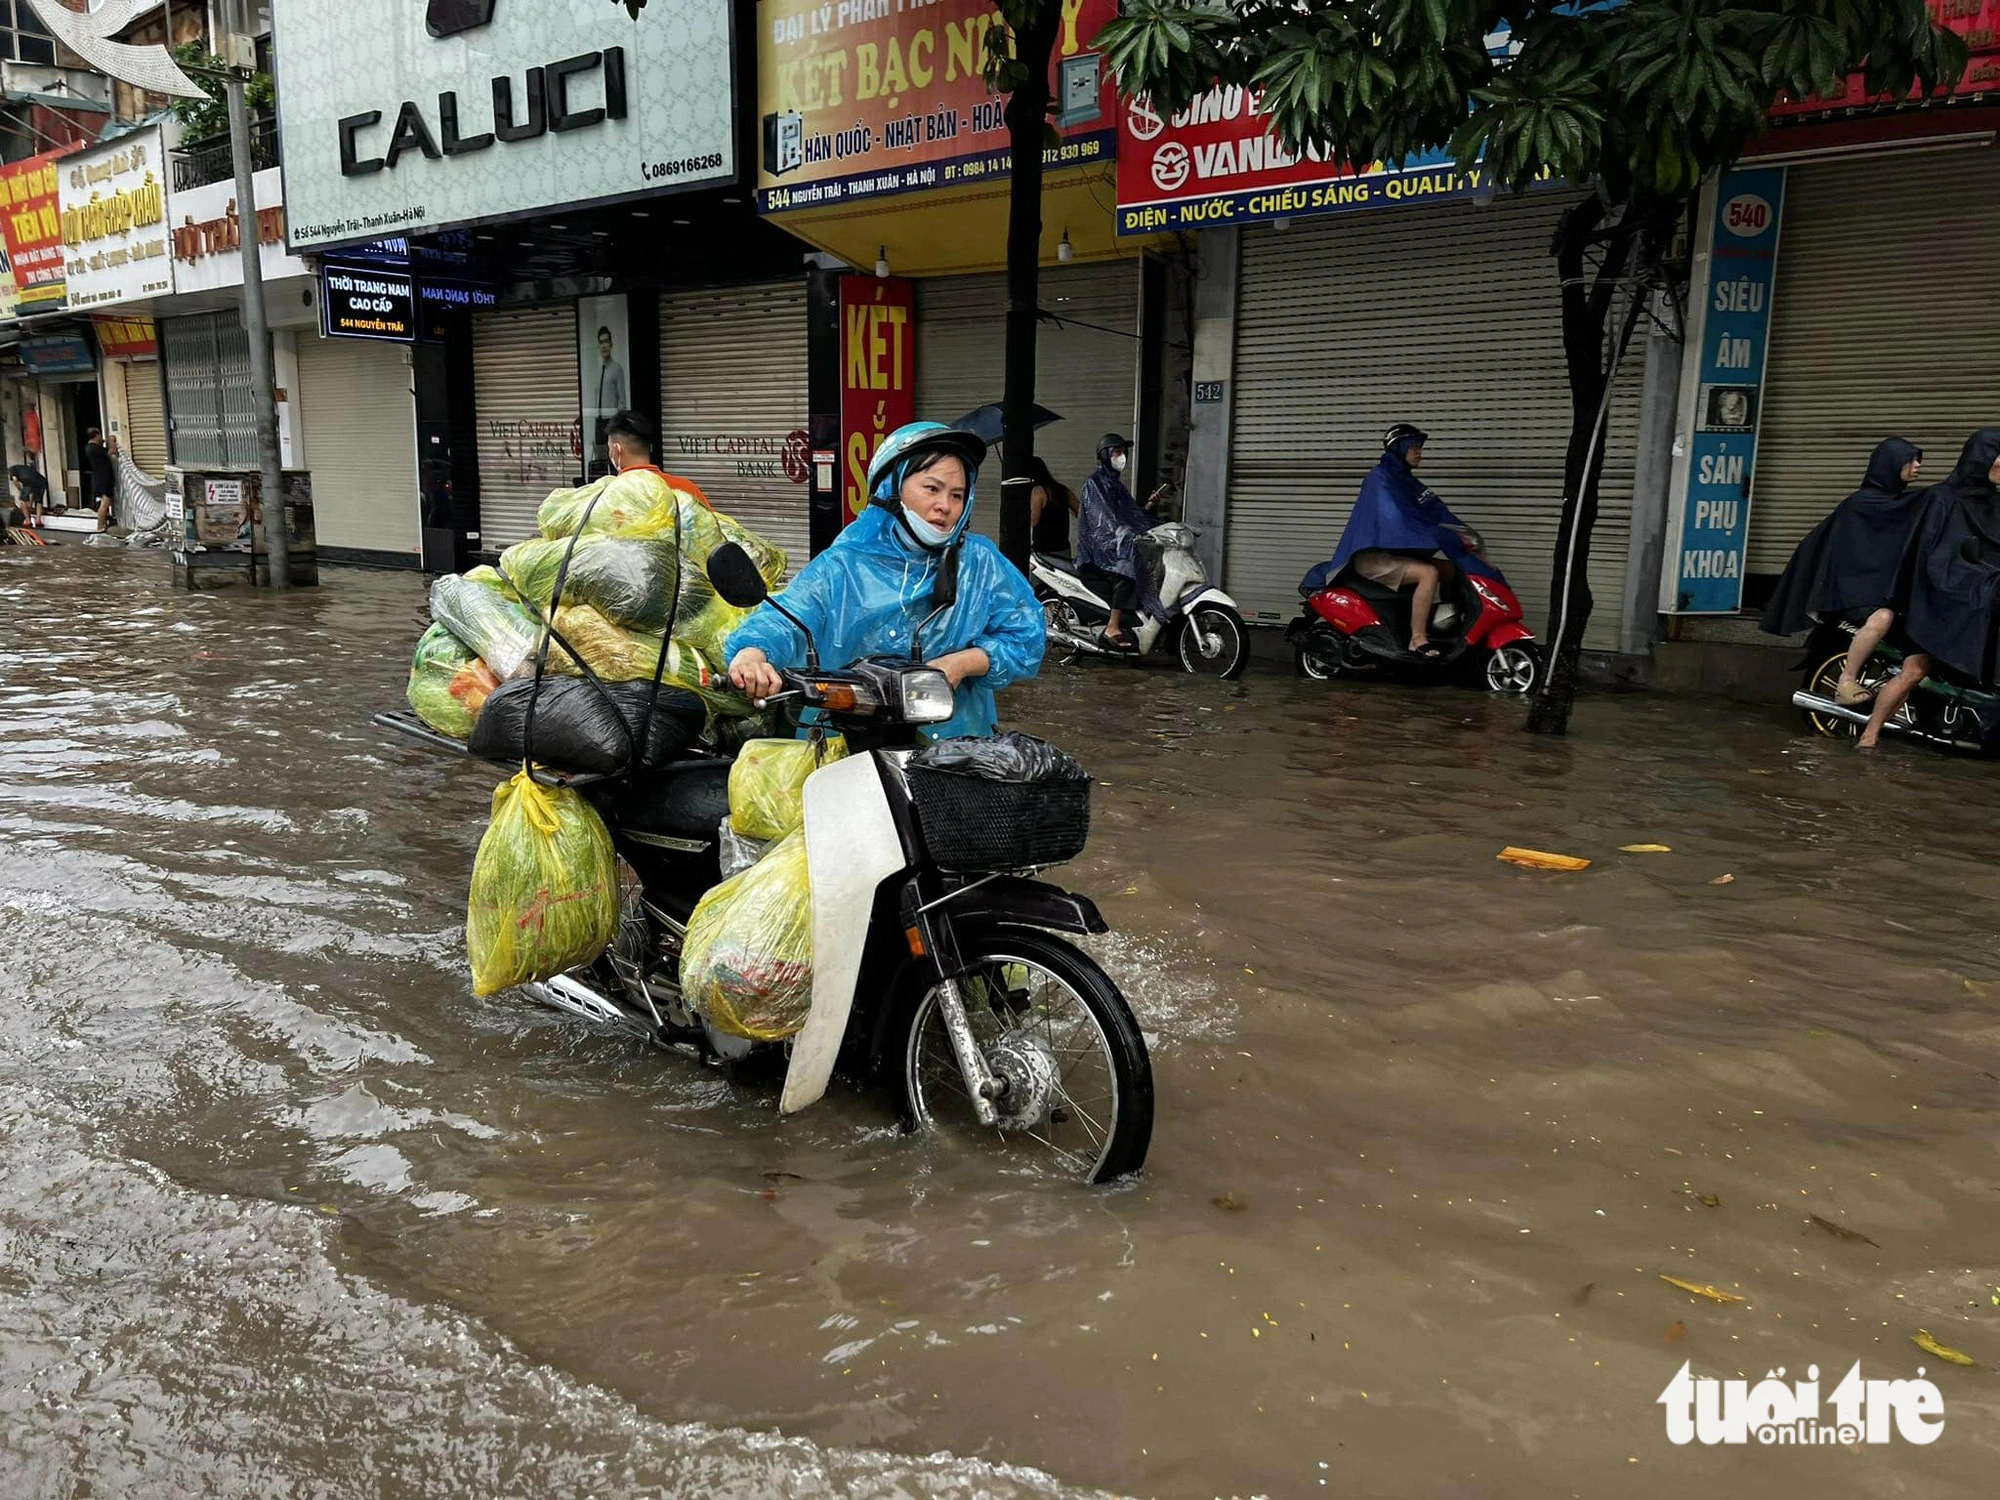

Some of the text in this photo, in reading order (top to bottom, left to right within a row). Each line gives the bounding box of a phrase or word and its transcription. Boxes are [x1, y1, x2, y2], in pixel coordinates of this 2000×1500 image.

[777, 39, 848, 111] KÉT
[855, 28, 935, 109] BẠC
[338, 46, 627, 177] CALUCI
[804, 131, 834, 164] HÀN
[835, 118, 871, 158] QUỐC
[884, 115, 923, 150] NHẬT
[926, 105, 957, 142] BẢN
[652, 153, 723, 178] 0869166268
[767, 189, 790, 210] 544
[791, 182, 823, 204] NGUYỄN
[824, 179, 843, 200] TRÃI
[848, 177, 875, 196] THANH
[876, 172, 899, 192] XUÂN
[906, 171, 918, 189] HÀ
[920, 168, 936, 187] NỘI
[963, 161, 985, 177] 0984
[988, 158, 999, 172] 14
[1001, 155, 1012, 170] 14
[1060, 144, 1079, 160] 930
[1081, 140, 1101, 157] 969
[1125, 207, 1168, 233] ĐIỆN
[1180, 198, 1235, 222] NƯỚC
[1248, 186, 1307, 215] CHIẾU
[1311, 180, 1370, 209] SÁNG
[1729, 203, 1766, 228] 540
[328, 275, 410, 297] THỜI TRANG NAM
[1714, 275, 1766, 314] SIÊU
[349, 296, 393, 313] CAO CẤP
[340, 318, 354, 328] 544
[354, 317, 386, 331] NGUYỄN
[847, 286, 907, 390] KÉT
[1714, 334, 1751, 369] ÂM
[1196, 383, 1223, 401] 542
[518, 418, 567, 438] CAPITAL
[715, 434, 778, 454] CAPITAL
[737, 460, 777, 478] BANK
[1698, 443, 1744, 486] SẢN
[1695, 499, 1738, 537] PHỤ
[1682, 548, 1740, 580] KHOA
